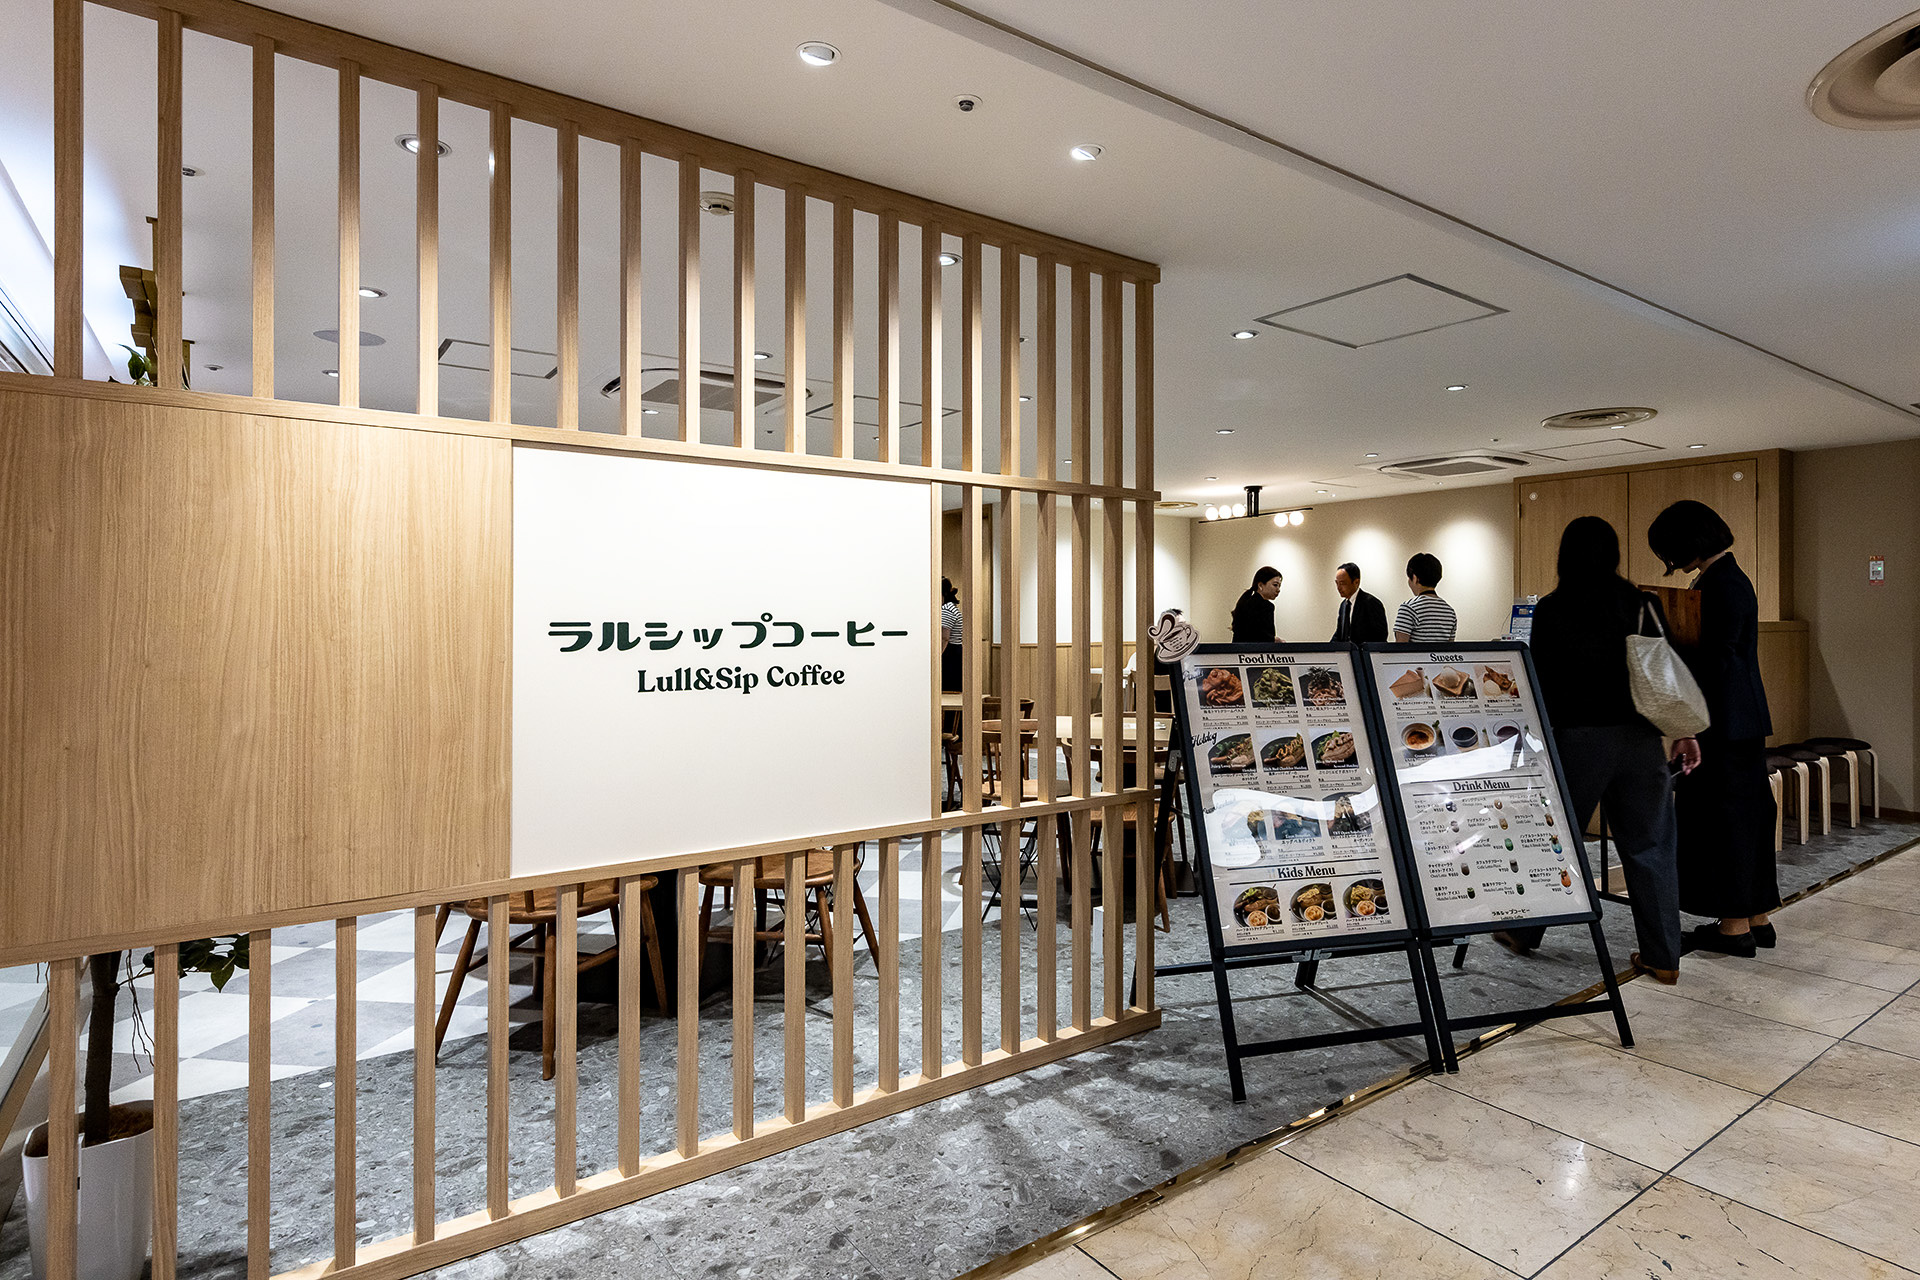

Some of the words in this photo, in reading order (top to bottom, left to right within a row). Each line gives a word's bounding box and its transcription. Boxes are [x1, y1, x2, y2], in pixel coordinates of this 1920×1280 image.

[548, 612, 908, 652] ラルシップコーヒー
[1238, 654, 1265, 664] Food
[1267, 653, 1295, 664] Menu
[1430, 653, 1464, 662] Sweets
[637, 666, 759, 694] Lull&Sip
[766, 664, 845, 688] Coffee
[1453, 780, 1482, 791] Drink
[1484, 779, 1510, 789] Menu
[1278, 867, 1303, 878] Kids
[1305, 866, 1336, 876] Menu
